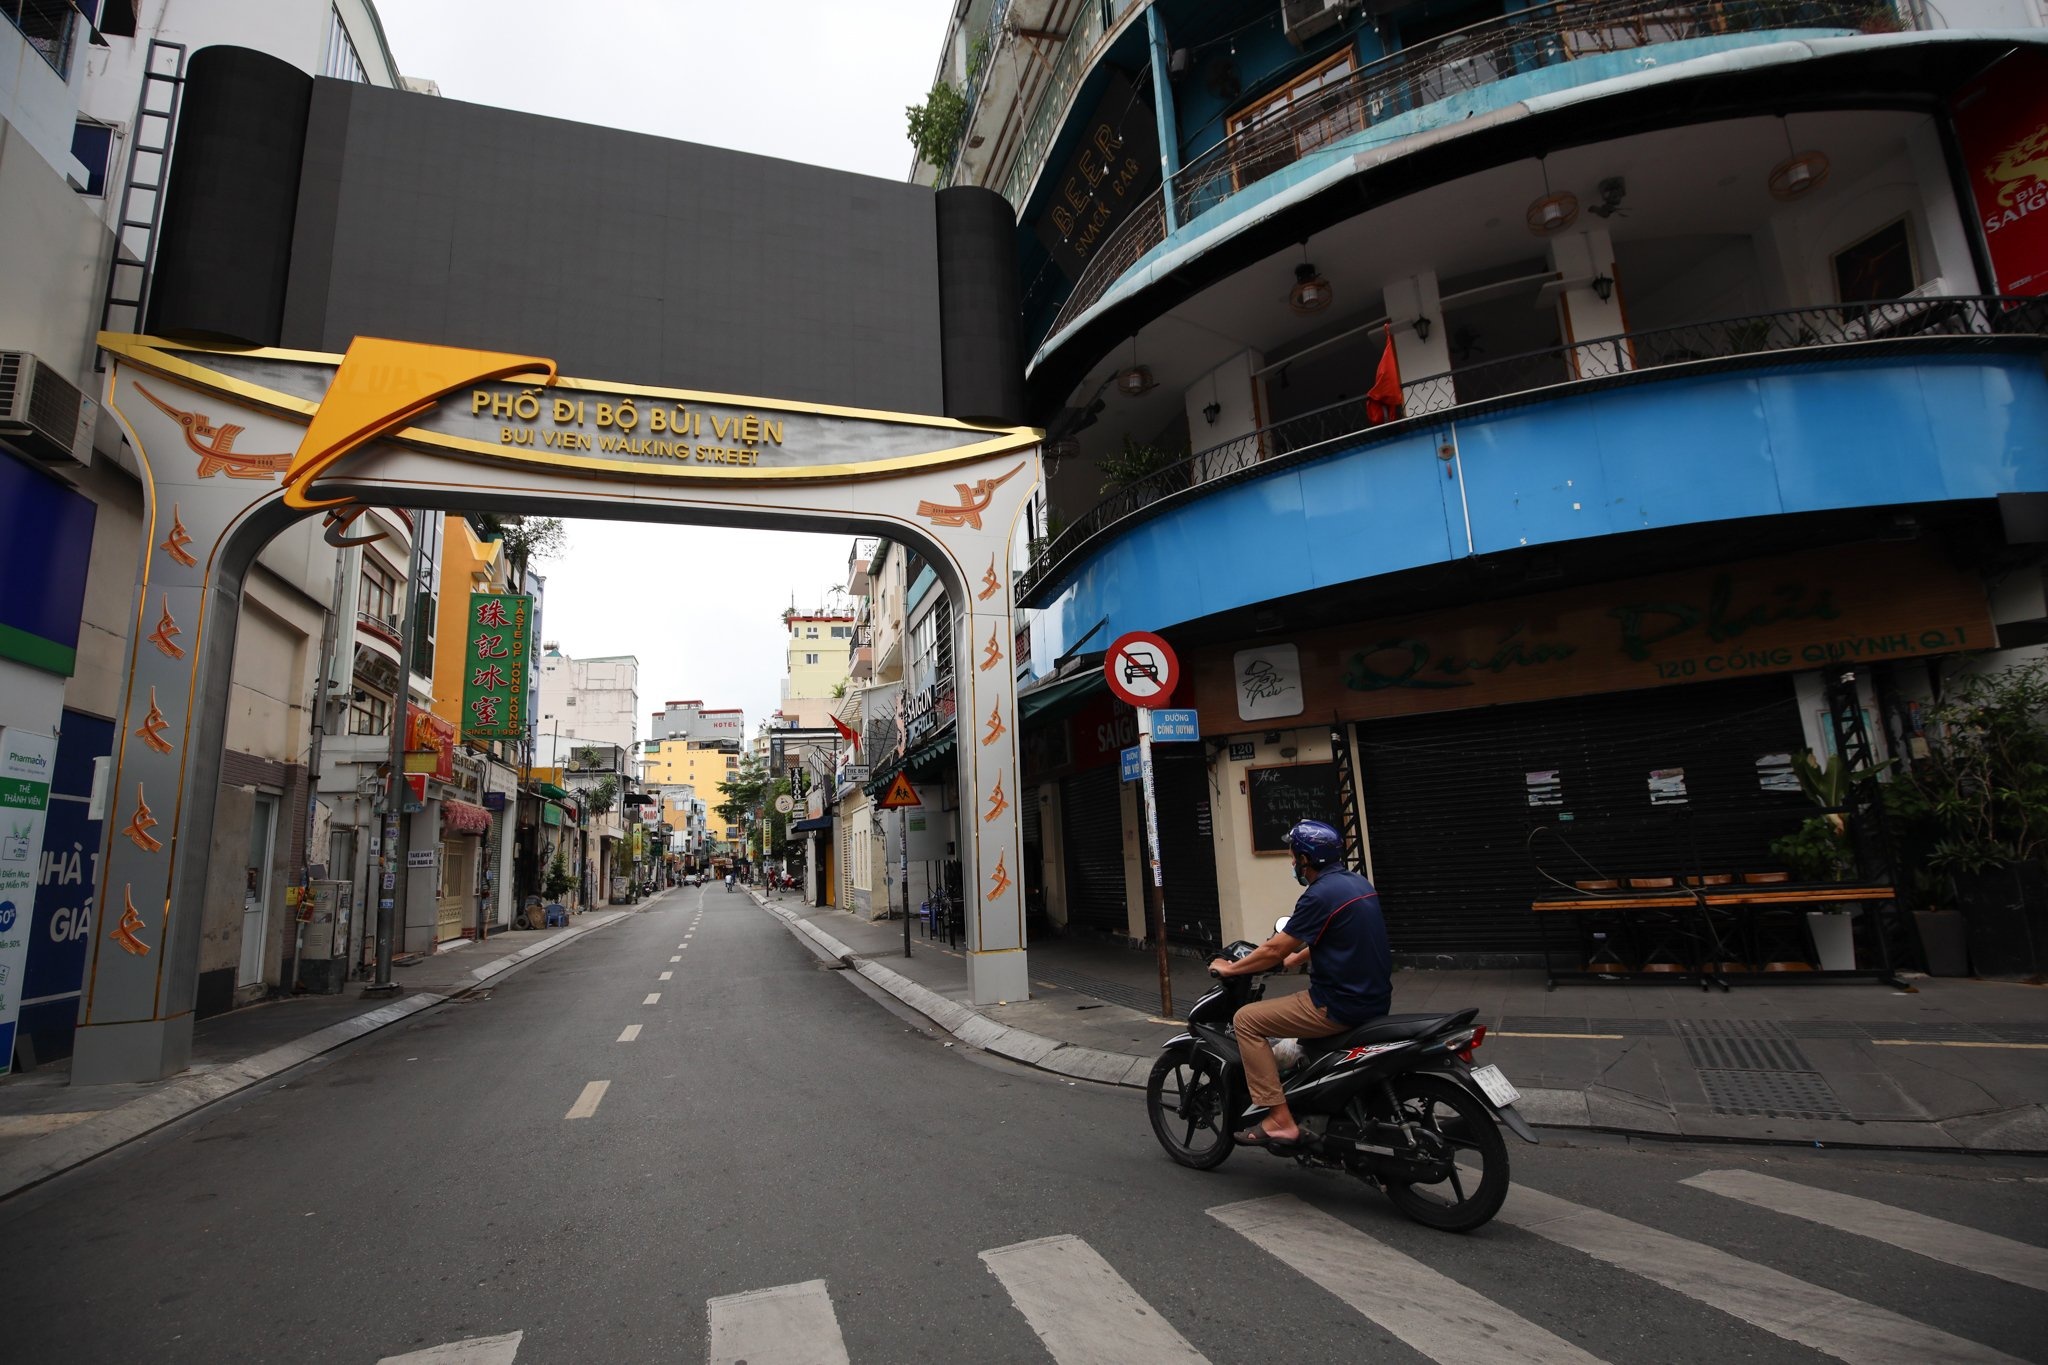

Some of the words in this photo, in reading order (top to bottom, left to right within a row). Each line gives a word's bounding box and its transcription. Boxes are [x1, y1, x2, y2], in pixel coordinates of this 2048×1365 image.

[1052, 123, 1122, 237] BEER
[2014, 181, 2048, 205] BIA
[1074, 202, 1112, 257] SNACK
[1112, 158, 1141, 197] BAR
[1985, 191, 2048, 234] SAIG
[472, 388, 544, 420] PHỐ
[552, 399, 585, 428] ĐI
[596, 398, 640, 433] BỘ
[650, 404, 702, 437] BÙI
[711, 414, 784, 446] VIỆN
[500, 427, 535, 445] BUI
[541, 433, 592, 451] VIEN
[597, 436, 690, 460] WALKING
[695, 445, 759, 465] STREET
[513, 599, 526, 639] TASTE
[472, 598, 512, 727] 珠記冰室
[512, 641, 523, 657] OF
[1656, 659, 1698, 681] 120
[1704, 643, 1793, 674] CỐNG
[509, 661, 522, 694] HONG
[507, 697, 520, 730] KONG
[906, 685, 935, 724] SAIGON
[1164, 713, 1190, 722] ĐƯỜNG
[466, 729, 494, 737] SINCE
[497, 728, 521, 737] 1990
[1231, 743, 1253, 755] 120
[10, 752, 47, 768] Pharmacity
[793, 768, 801, 800] TATTOO
